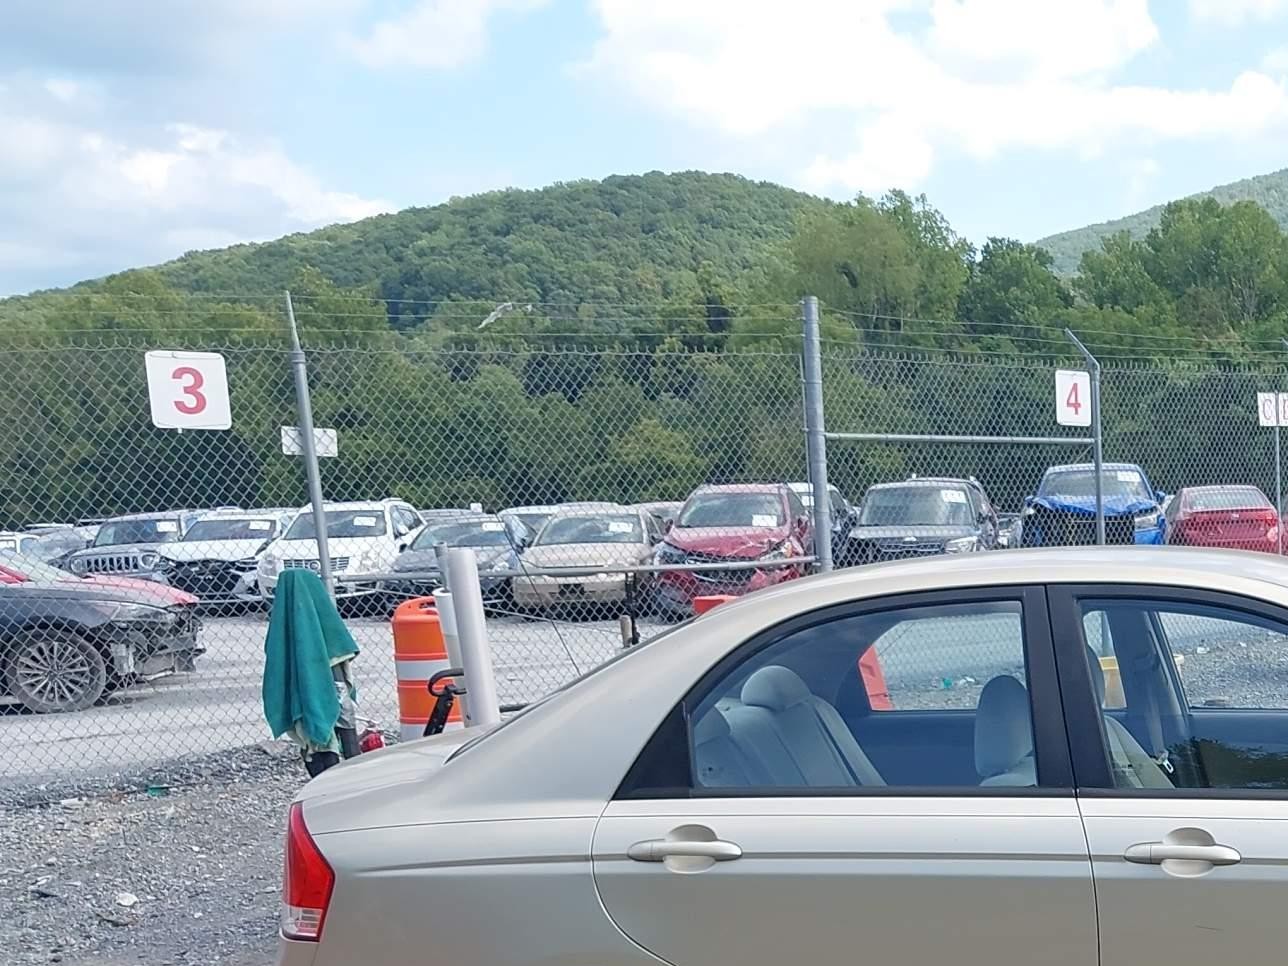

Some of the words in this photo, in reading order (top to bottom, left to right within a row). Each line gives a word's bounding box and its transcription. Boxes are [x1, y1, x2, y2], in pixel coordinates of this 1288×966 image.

[172, 366, 207, 415] 3
[1067, 382, 1081, 415] 4
[1262, 398, 1272, 420] C
